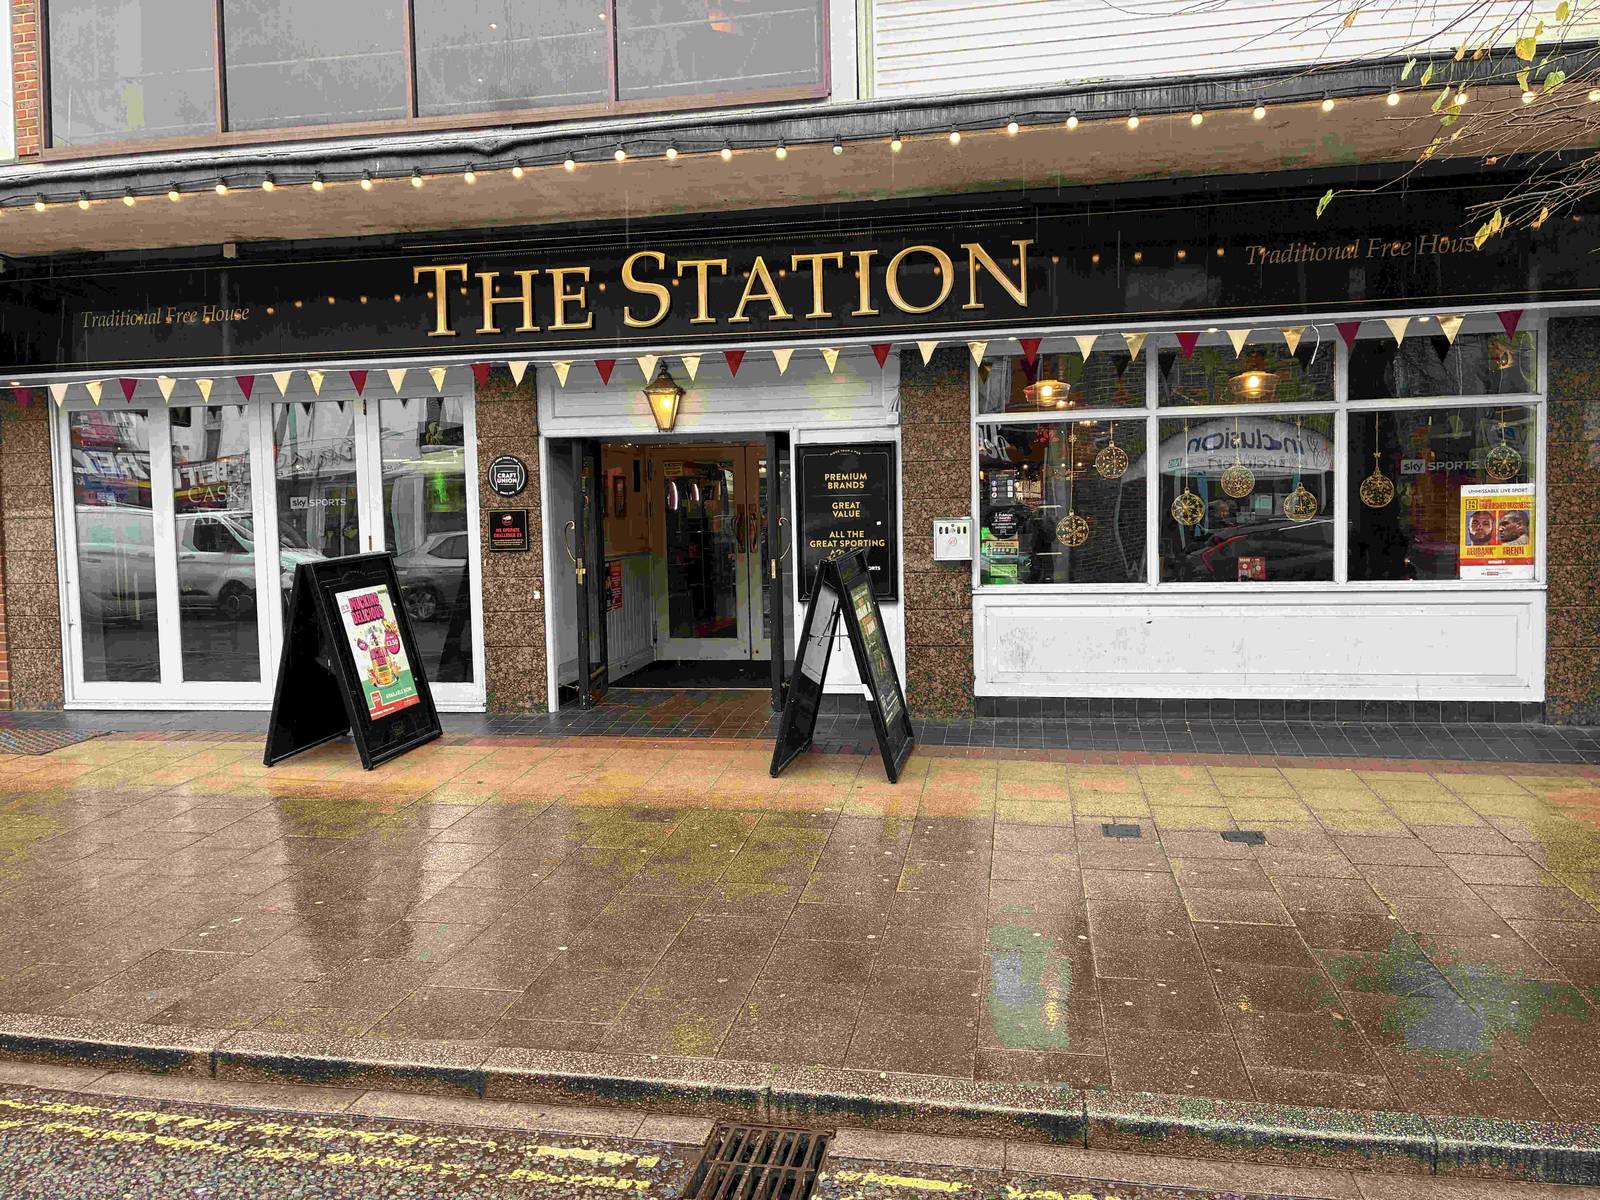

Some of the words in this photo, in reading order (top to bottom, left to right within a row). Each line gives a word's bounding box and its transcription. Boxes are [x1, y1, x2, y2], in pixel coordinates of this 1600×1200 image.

[1246, 239, 1360, 265] Traditional
[1366, 238, 1411, 258] Free
[1416, 234, 1483, 254] Hous
[412, 263, 594, 338] THE
[622, 239, 1034, 328] STATION
[80, 307, 161, 328] Traditional
[165, 306, 197, 324] Free
[202, 303, 250, 321] House
[1403, 461, 1423, 472] sky
[1427, 460, 1480, 471] SPORTS
[824, 473, 868, 481] PREMIUM
[827, 481, 865, 490] BRANDS
[188, 484, 242, 503] CASK
[309, 498, 347, 507] SPORTS
[832, 501, 861, 510] GREAT
[833, 510, 861, 518] VALUE
[810, 540, 838, 548] GREAT
[839, 539, 885, 548] SPORTING
